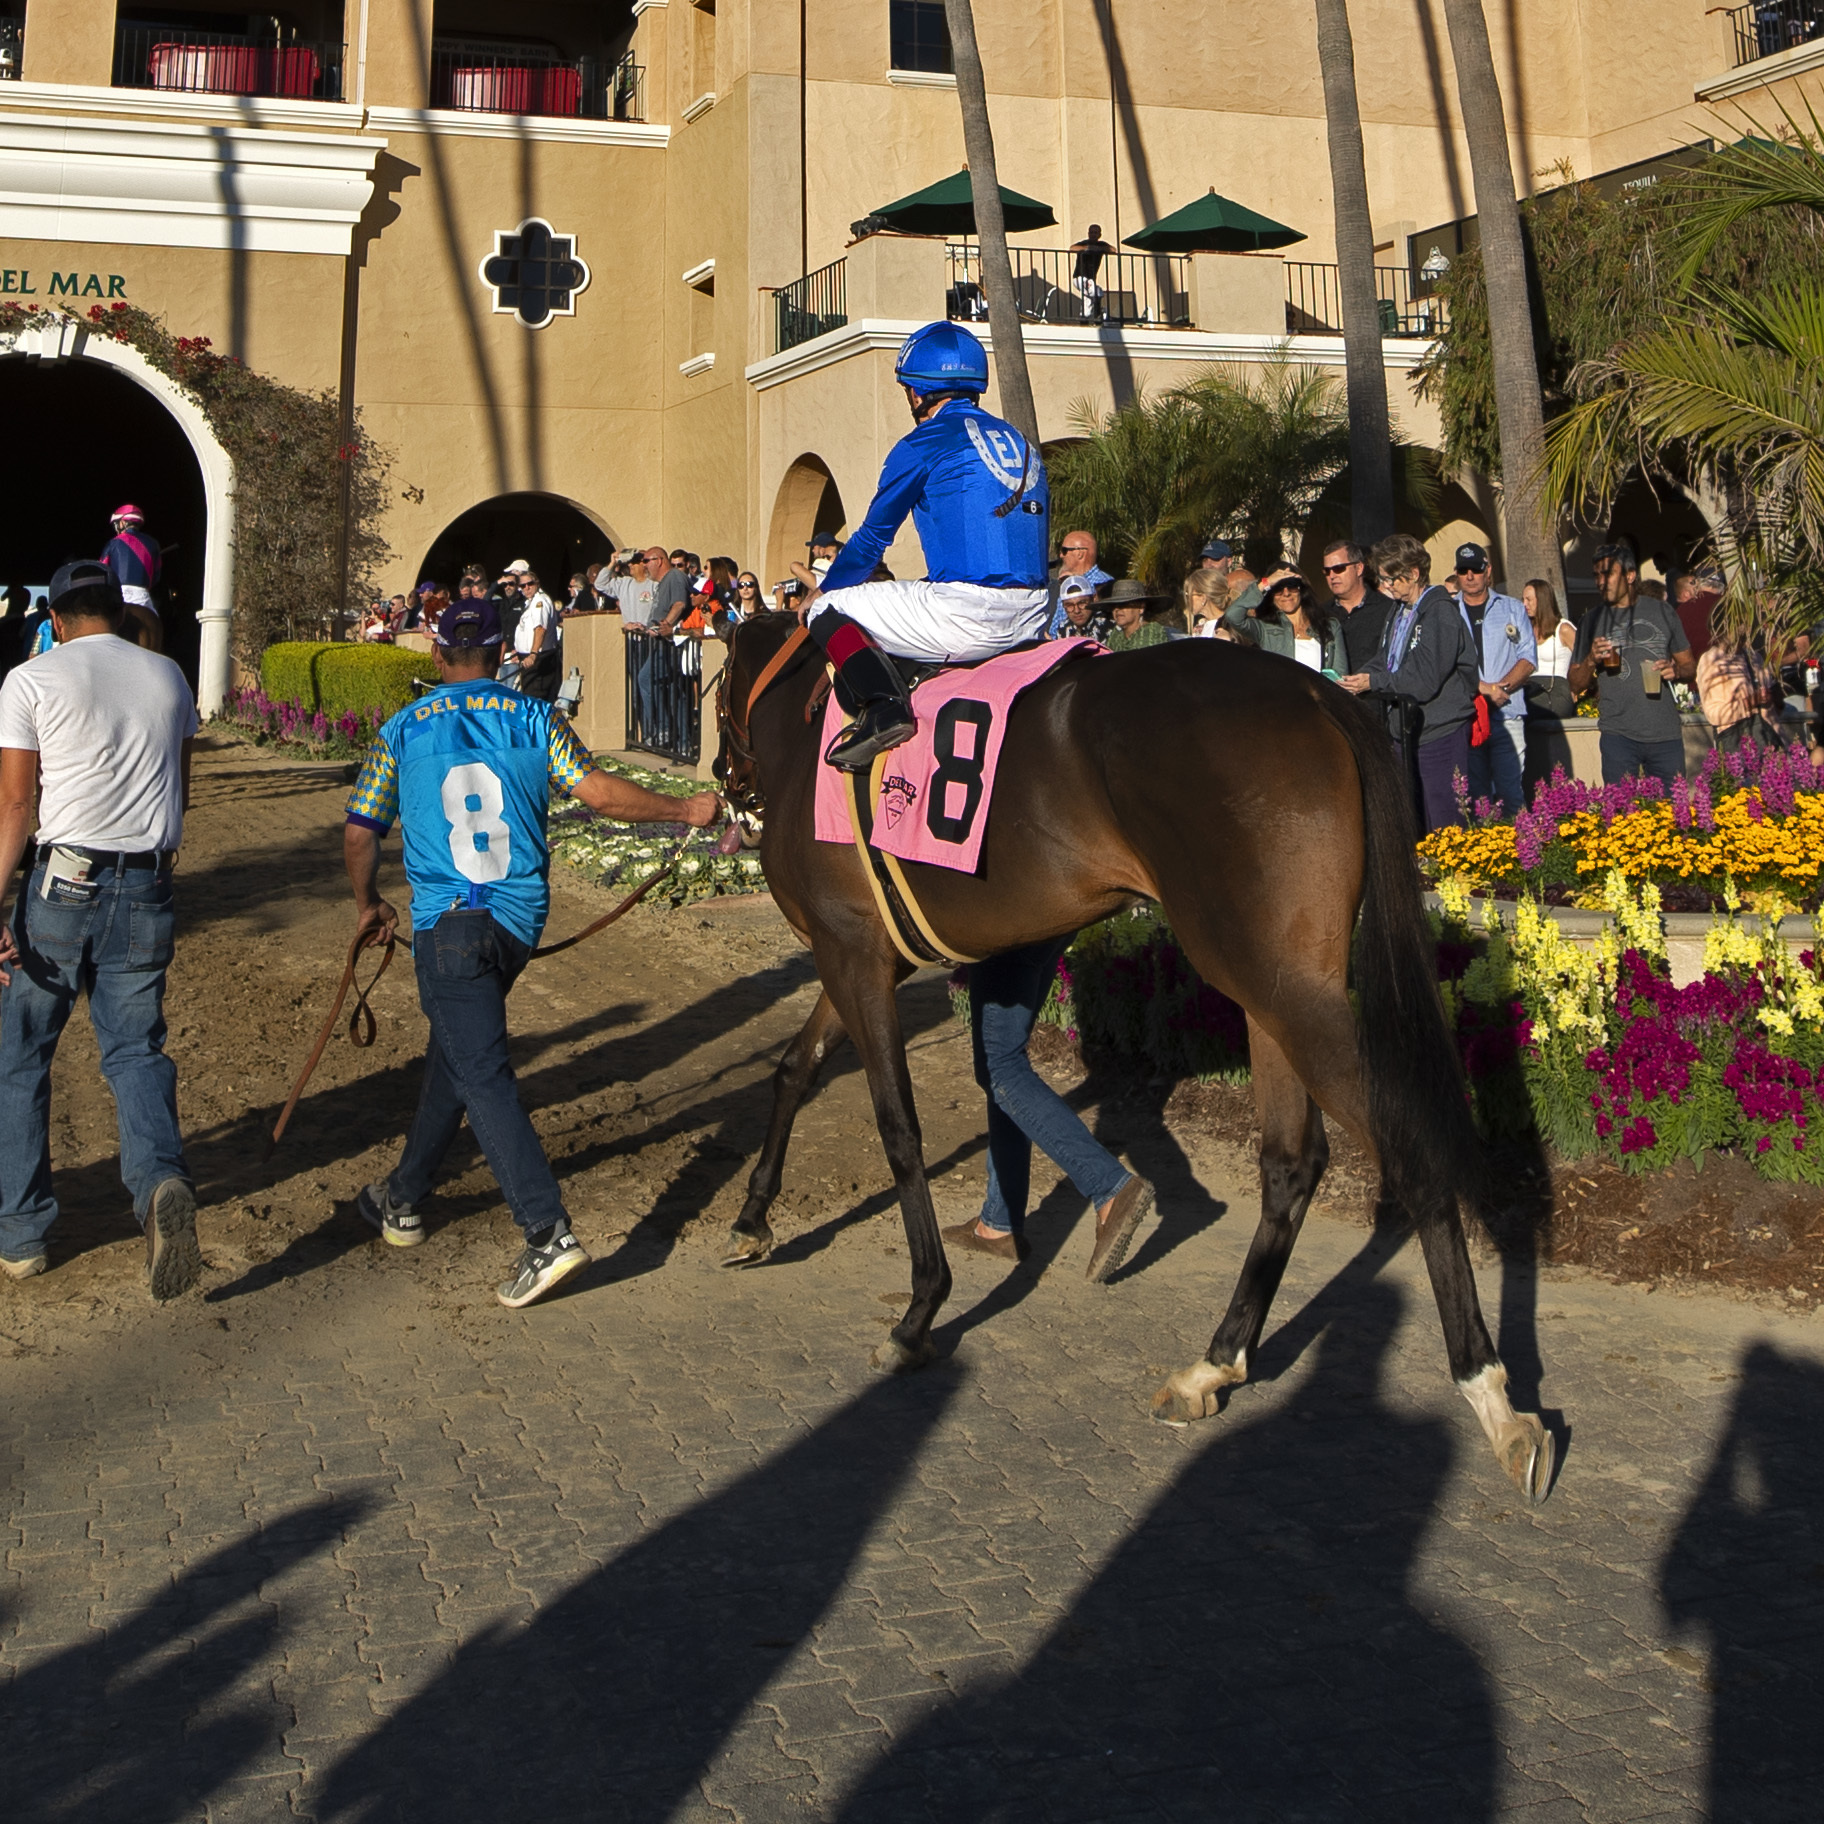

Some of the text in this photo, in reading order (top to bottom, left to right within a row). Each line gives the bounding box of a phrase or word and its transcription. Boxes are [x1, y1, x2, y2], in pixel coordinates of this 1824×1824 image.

[47, 272, 128, 298] MAR
[1030, 501, 1038, 514] 6
[415, 695, 518, 721] DEL MAR
[927, 697, 994, 846] 8
[441, 762, 512, 884] 8
